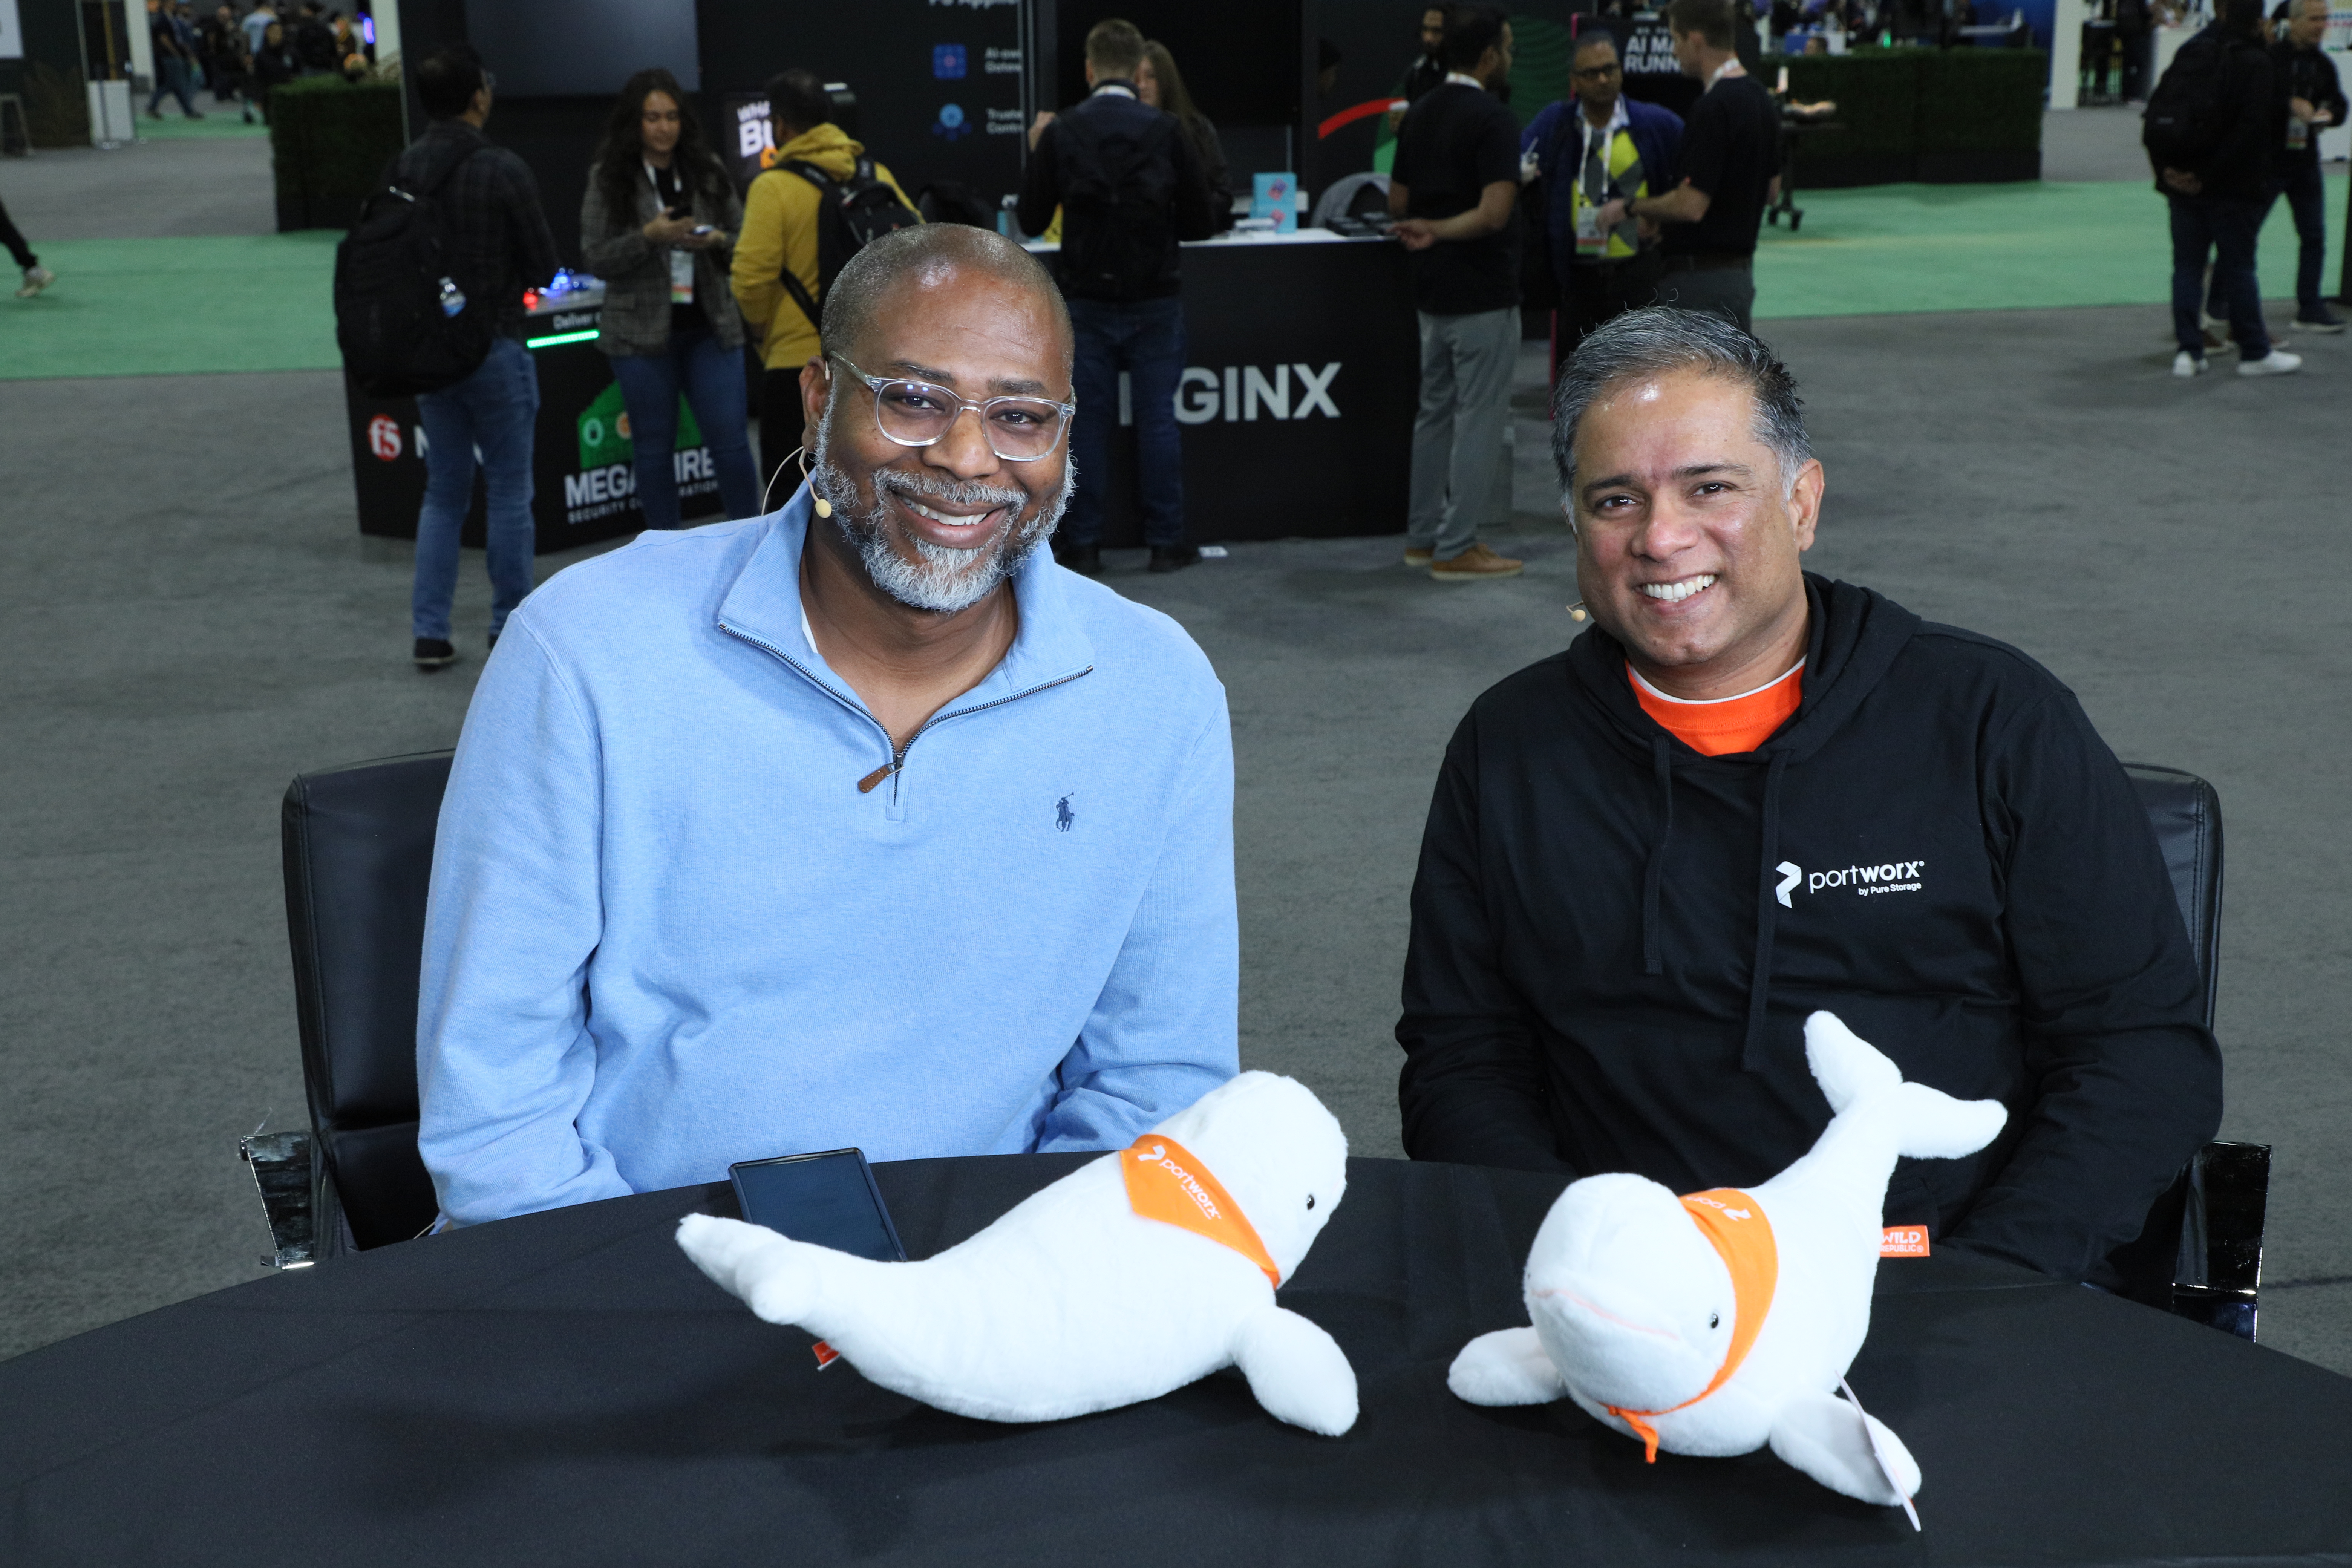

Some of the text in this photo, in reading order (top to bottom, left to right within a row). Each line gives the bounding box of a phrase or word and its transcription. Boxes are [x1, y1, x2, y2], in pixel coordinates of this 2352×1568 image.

[1626, 35, 1646, 52] AI
[1858, 882, 1922, 896] by Pure Storage
[1882, 1231, 1921, 1244] WILD
